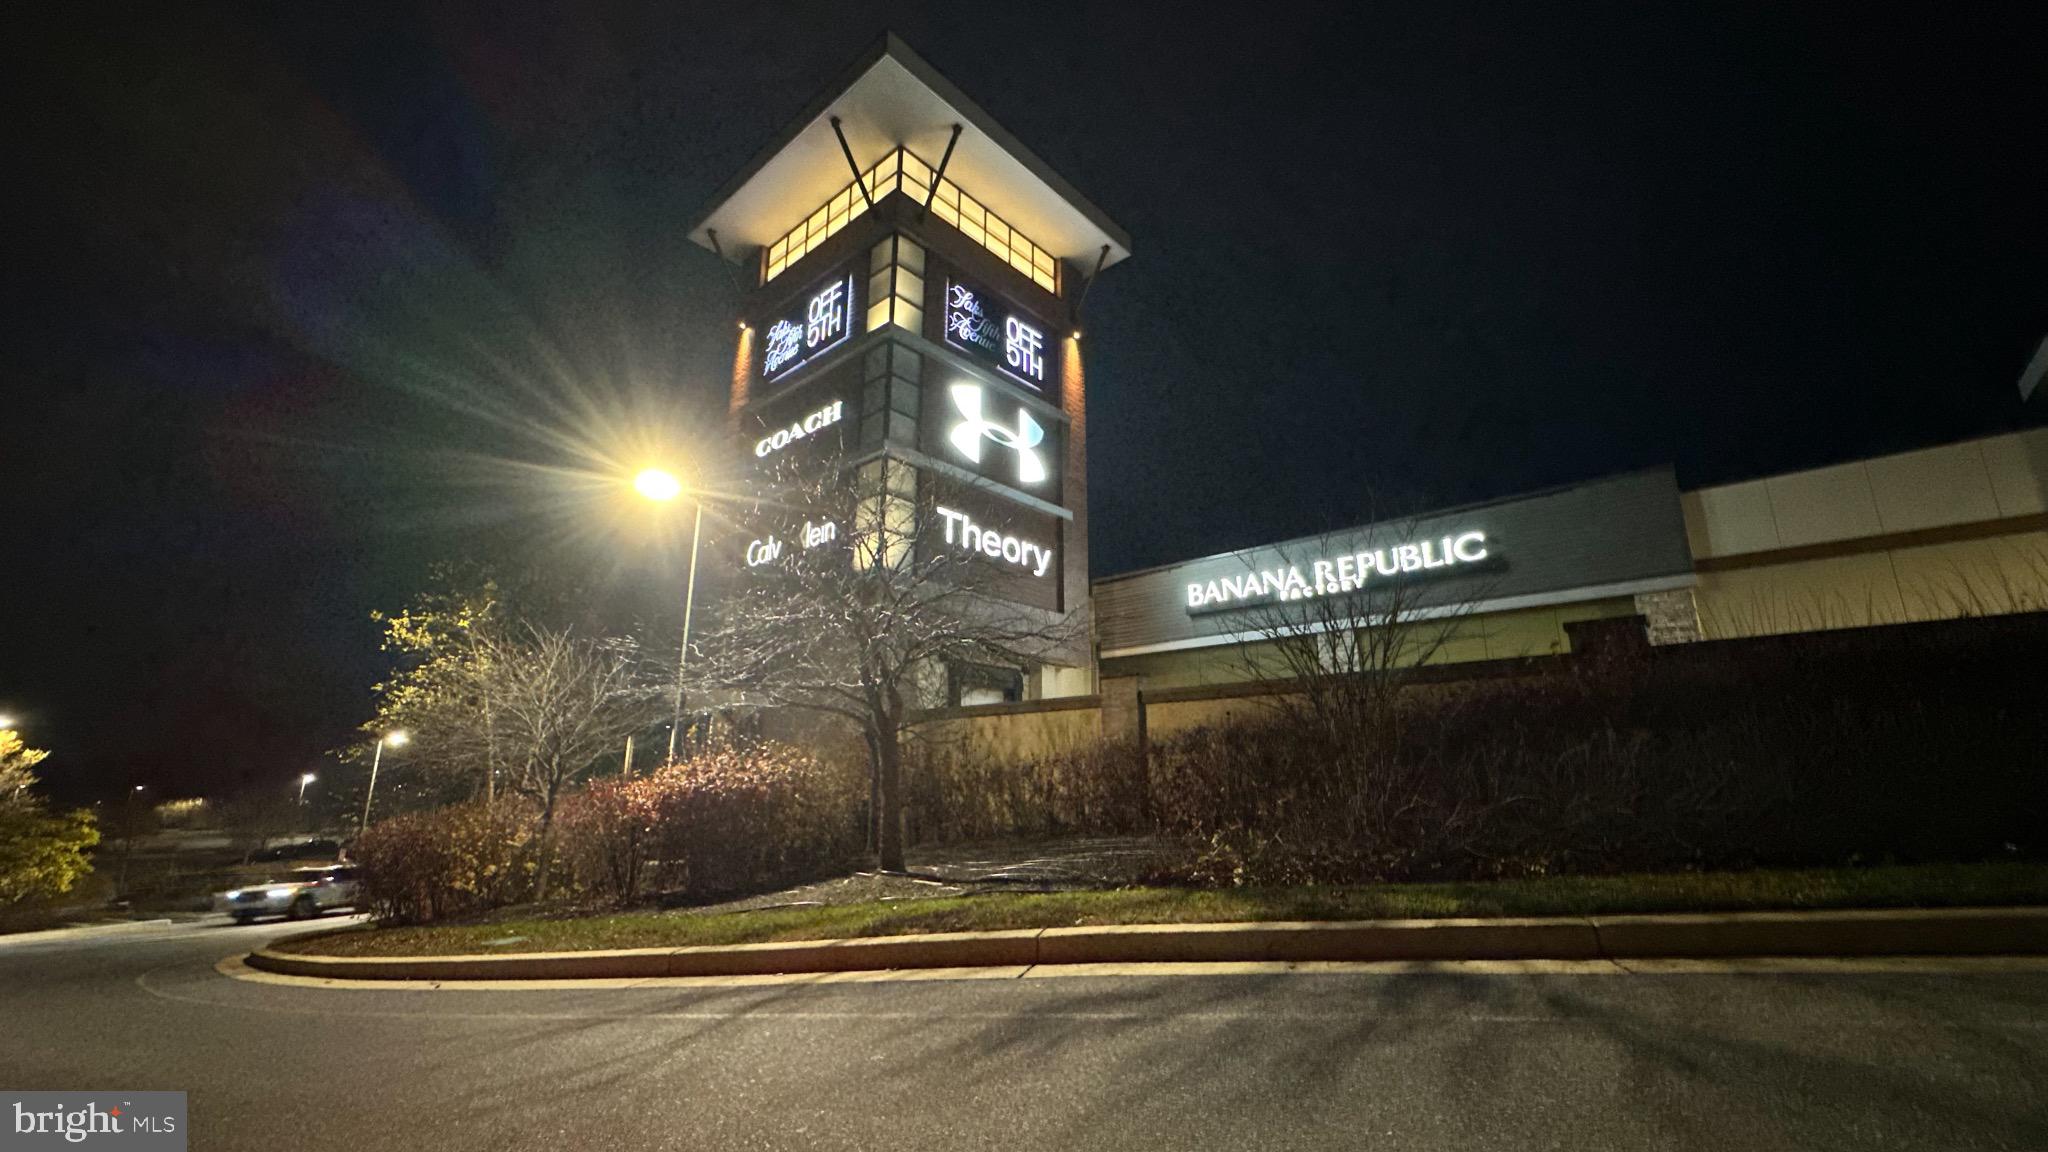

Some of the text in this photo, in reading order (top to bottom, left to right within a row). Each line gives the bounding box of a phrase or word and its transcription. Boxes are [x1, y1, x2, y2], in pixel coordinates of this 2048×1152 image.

[808, 280, 843, 323] OFF
[950, 285, 983, 317] Saks
[806, 305, 841, 347] 5TH
[949, 312, 996, 351] Avenue
[1006, 317, 1043, 348] OFF
[1006, 338, 1043, 380] 5TH
[755, 400, 843, 458] COACH
[937, 506, 1051, 577] Theory
[1187, 531, 1488, 607] BANANA REPUBLIC
